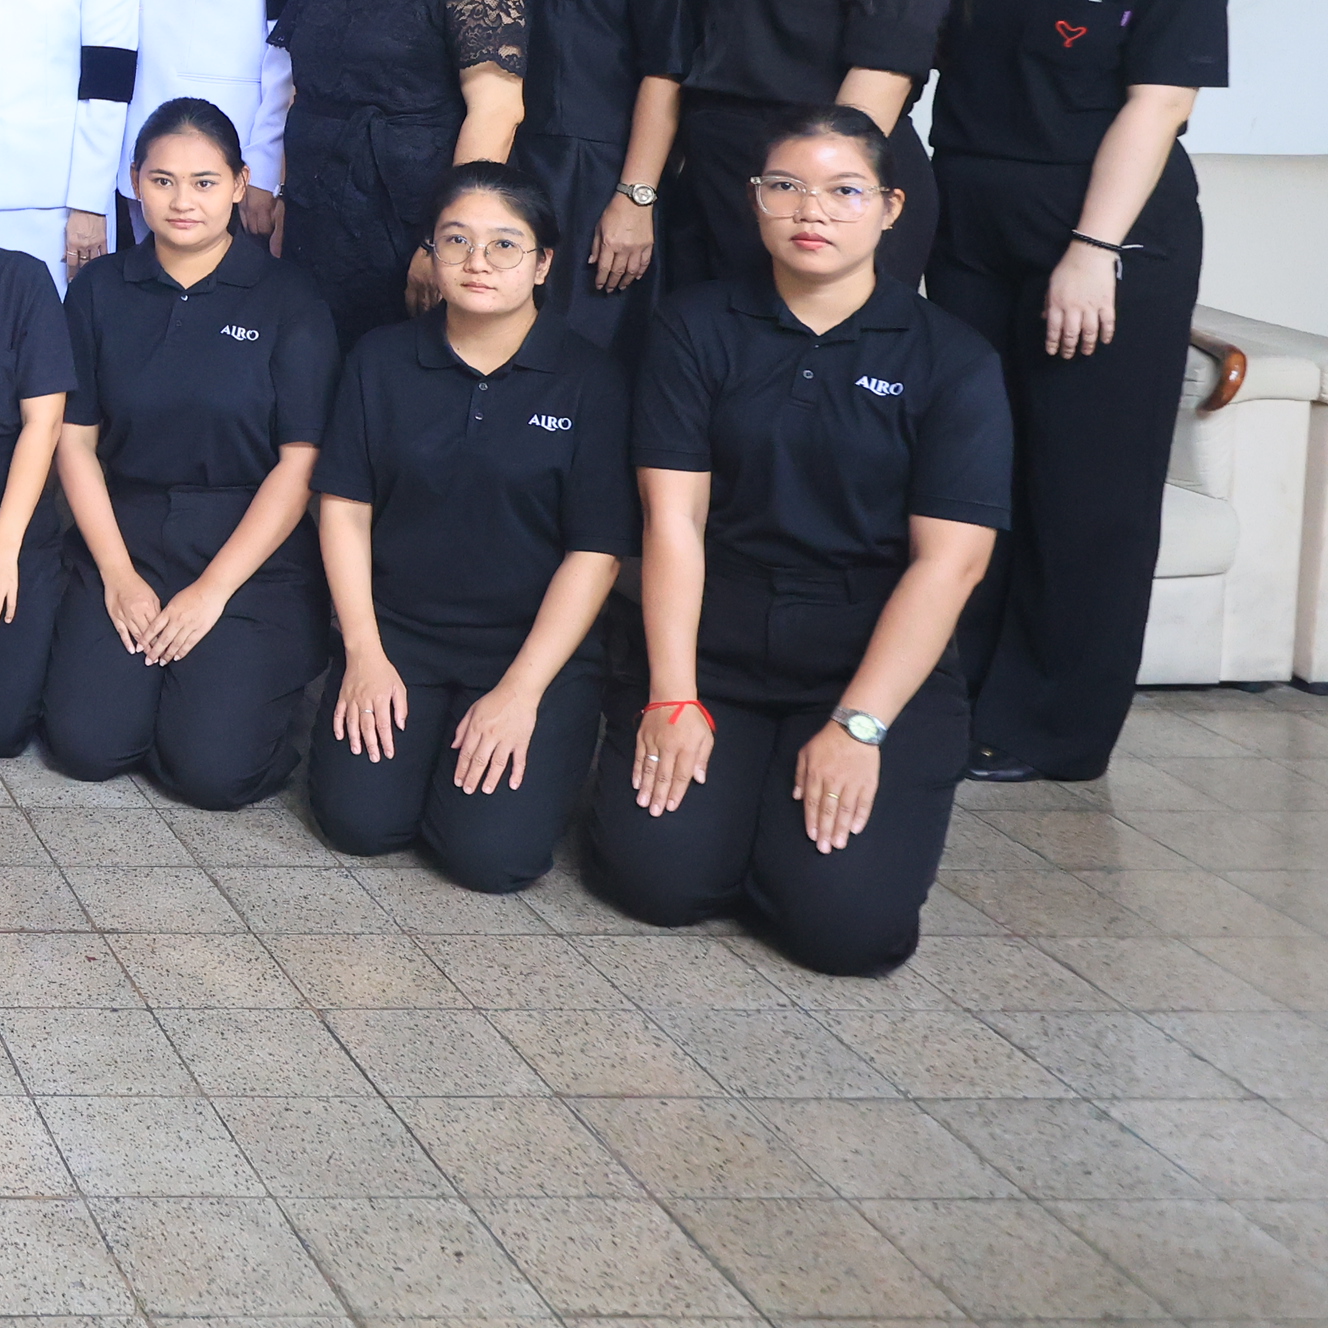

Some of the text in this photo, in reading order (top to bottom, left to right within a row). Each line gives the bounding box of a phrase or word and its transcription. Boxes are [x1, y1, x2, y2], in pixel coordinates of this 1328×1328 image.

[220, 324, 260, 341] ALRO
[854, 375, 904, 397] ALRO
[527, 413, 573, 432] ALRO
